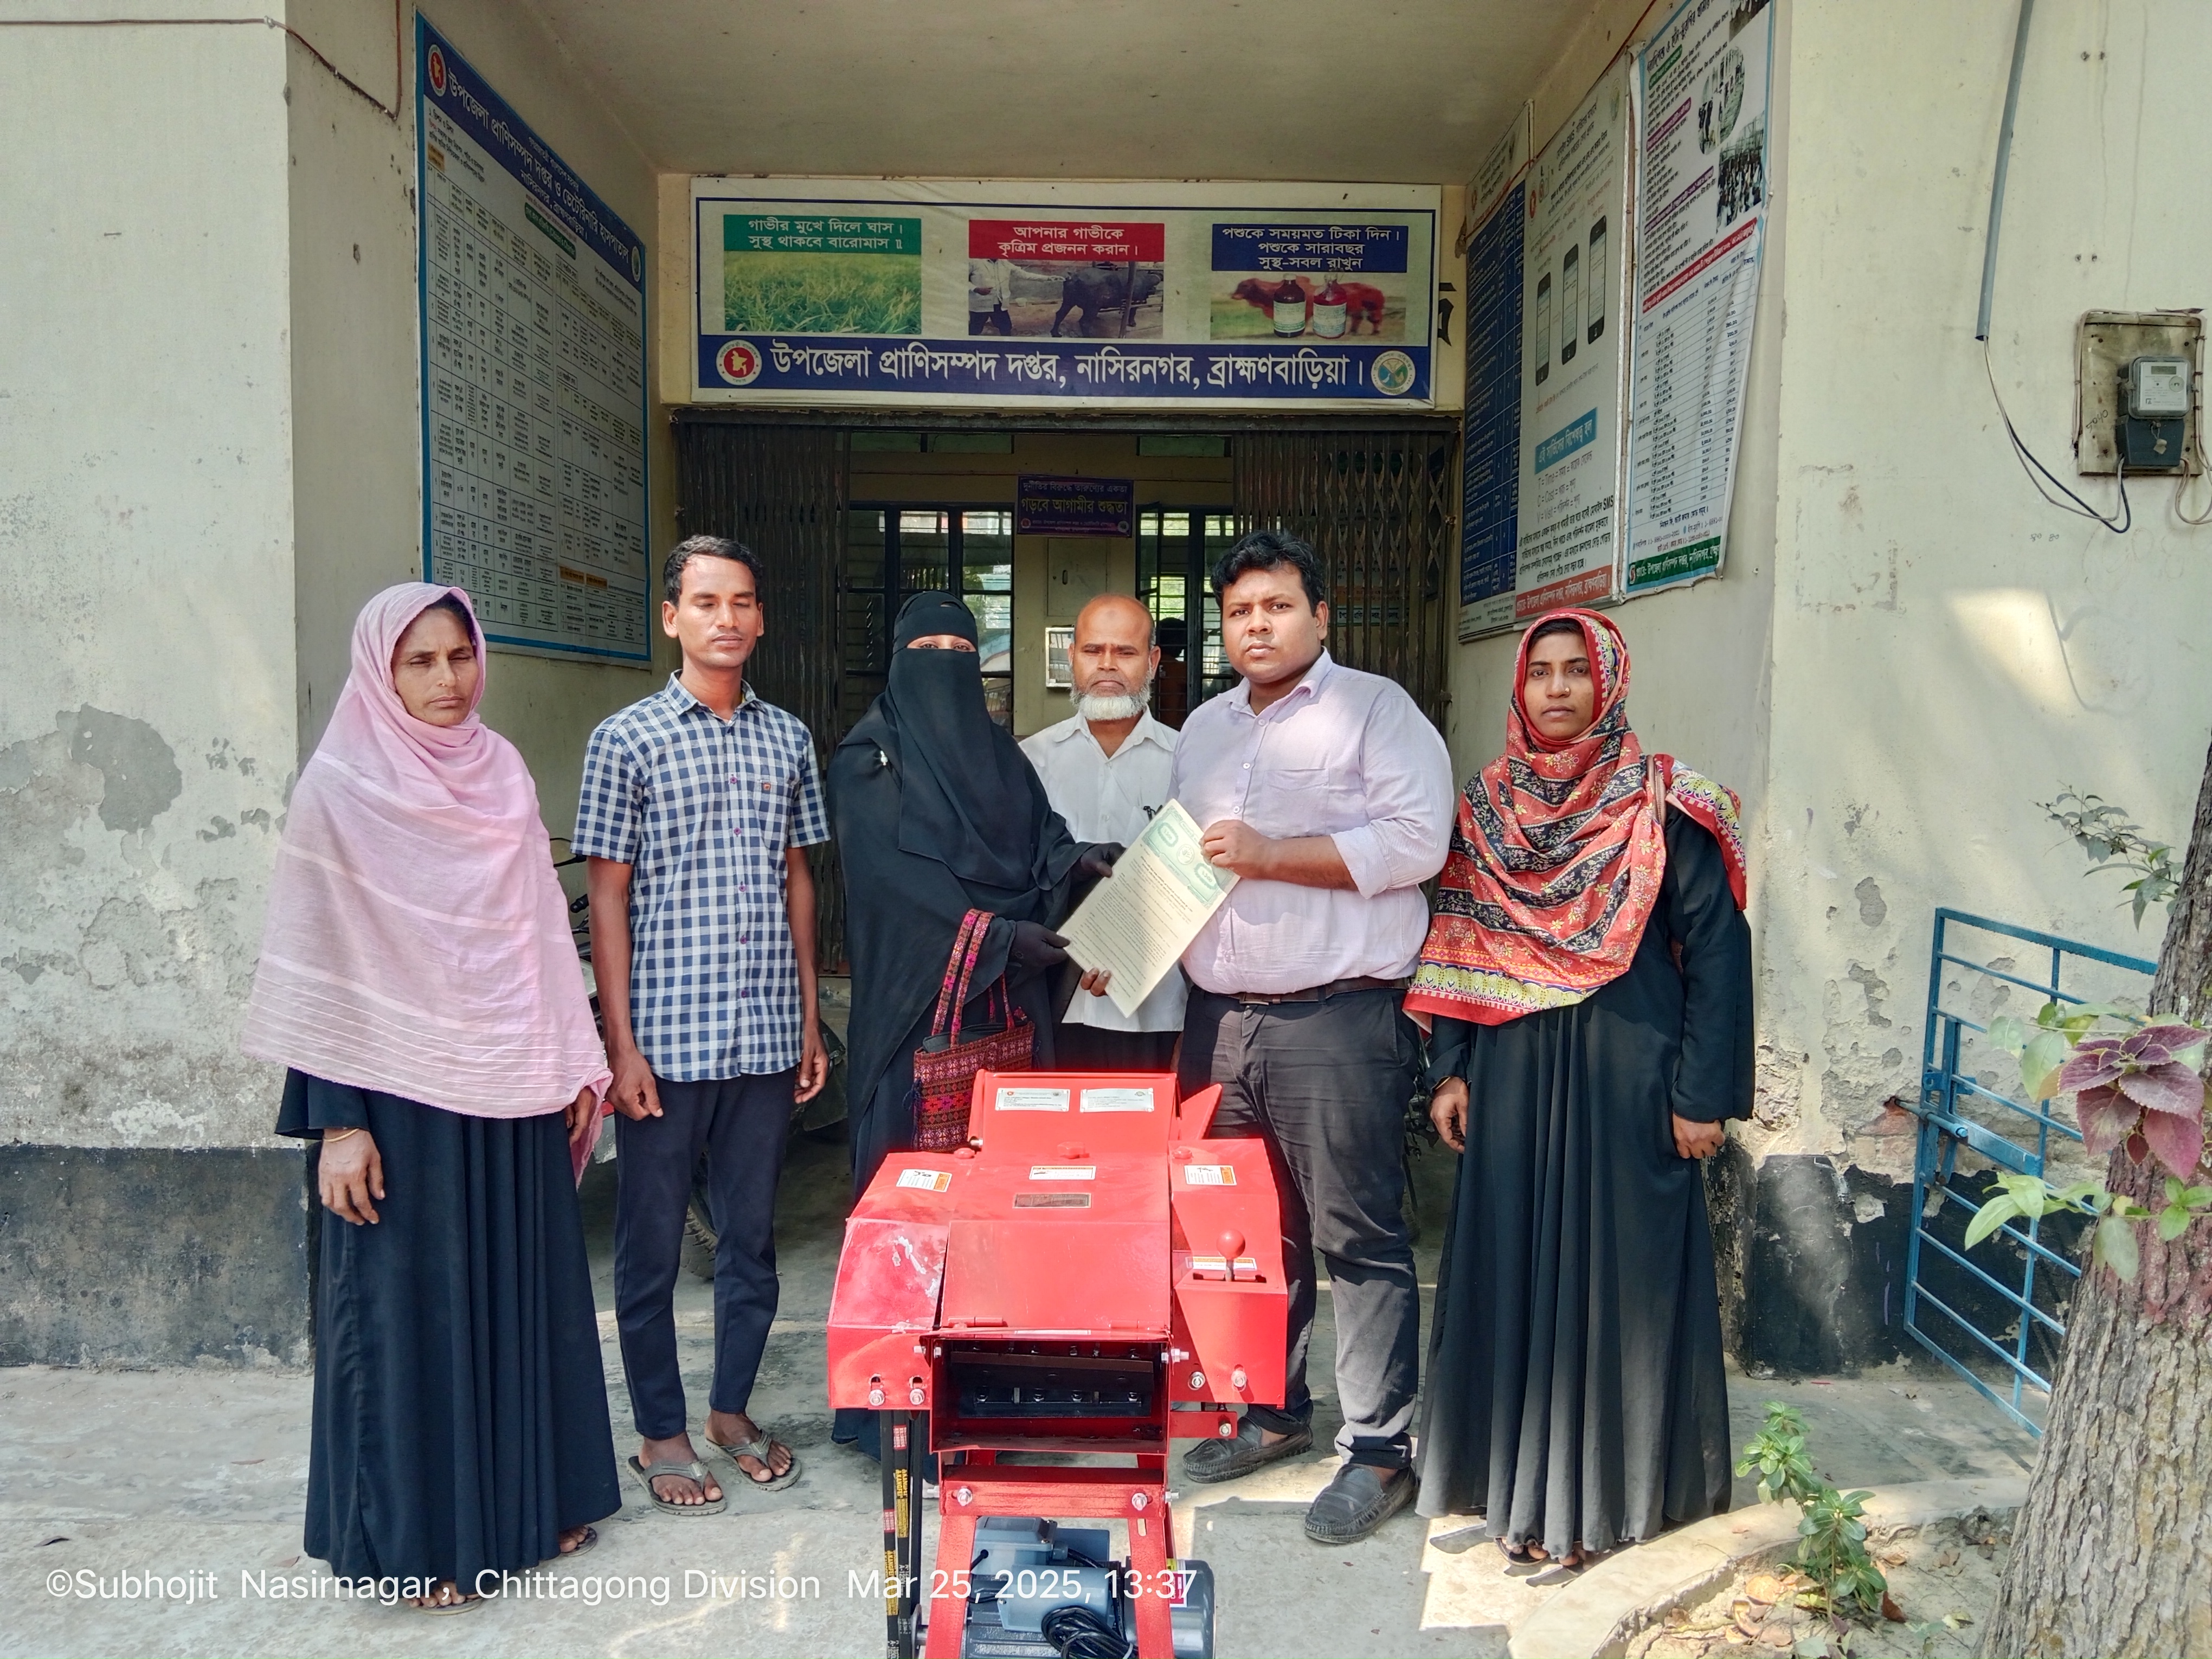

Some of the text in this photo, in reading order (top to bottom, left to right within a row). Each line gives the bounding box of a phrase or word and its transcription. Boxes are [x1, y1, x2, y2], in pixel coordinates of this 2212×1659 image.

[448, 68, 488, 130] উপজেলা
[491, 117, 533, 171] প্রাণিসম্পদ
[535, 159, 552, 190] দপ্তর
[555, 179, 562, 197] ও
[563, 187, 599, 234] ভেটেরিনারি
[600, 222, 629, 264] হাসপাতাল
[749, 217, 789, 232] গাভীর
[796, 221, 822, 234] মুখে
[829, 218, 861, 233] দিলে
[867, 222, 892, 234] ঘাস
[1013, 224, 1124, 240] আপনার গাভীকে
[1222, 227, 1264, 240] পশুকে
[1269, 228, 1323, 241] সময়মত
[1328, 226, 1361, 241] টিকা
[1366, 226, 1392, 241] দিন
[749, 236, 773, 250] সুস্থ
[779, 236, 821, 249] থাকবে
[828, 237, 888, 250] বারোমাস
[998, 240, 1036, 258] কৃত্রিম
[1042, 242, 1086, 256] প্রজনন
[1093, 243, 1130, 256] করান
[1258, 242, 1365, 255] পশুকে সারাবছর
[1259, 257, 1362, 271] সুস্থ-সবল রাখুন
[770, 338, 872, 378] উপজেলা
[879, 341, 999, 381] প্রাণিসম্পদ
[1005, 353, 1066, 388] দপ্তর,
[1074, 345, 1200, 389] নাসিরনগর,
[1207, 347, 1351, 389] ব্রাহ্মণবাড়িয়া
[1021, 494, 1129, 516] গড়বে আগামীর শুদ্ধতা
[1603, 494, 1613, 511] SMS
